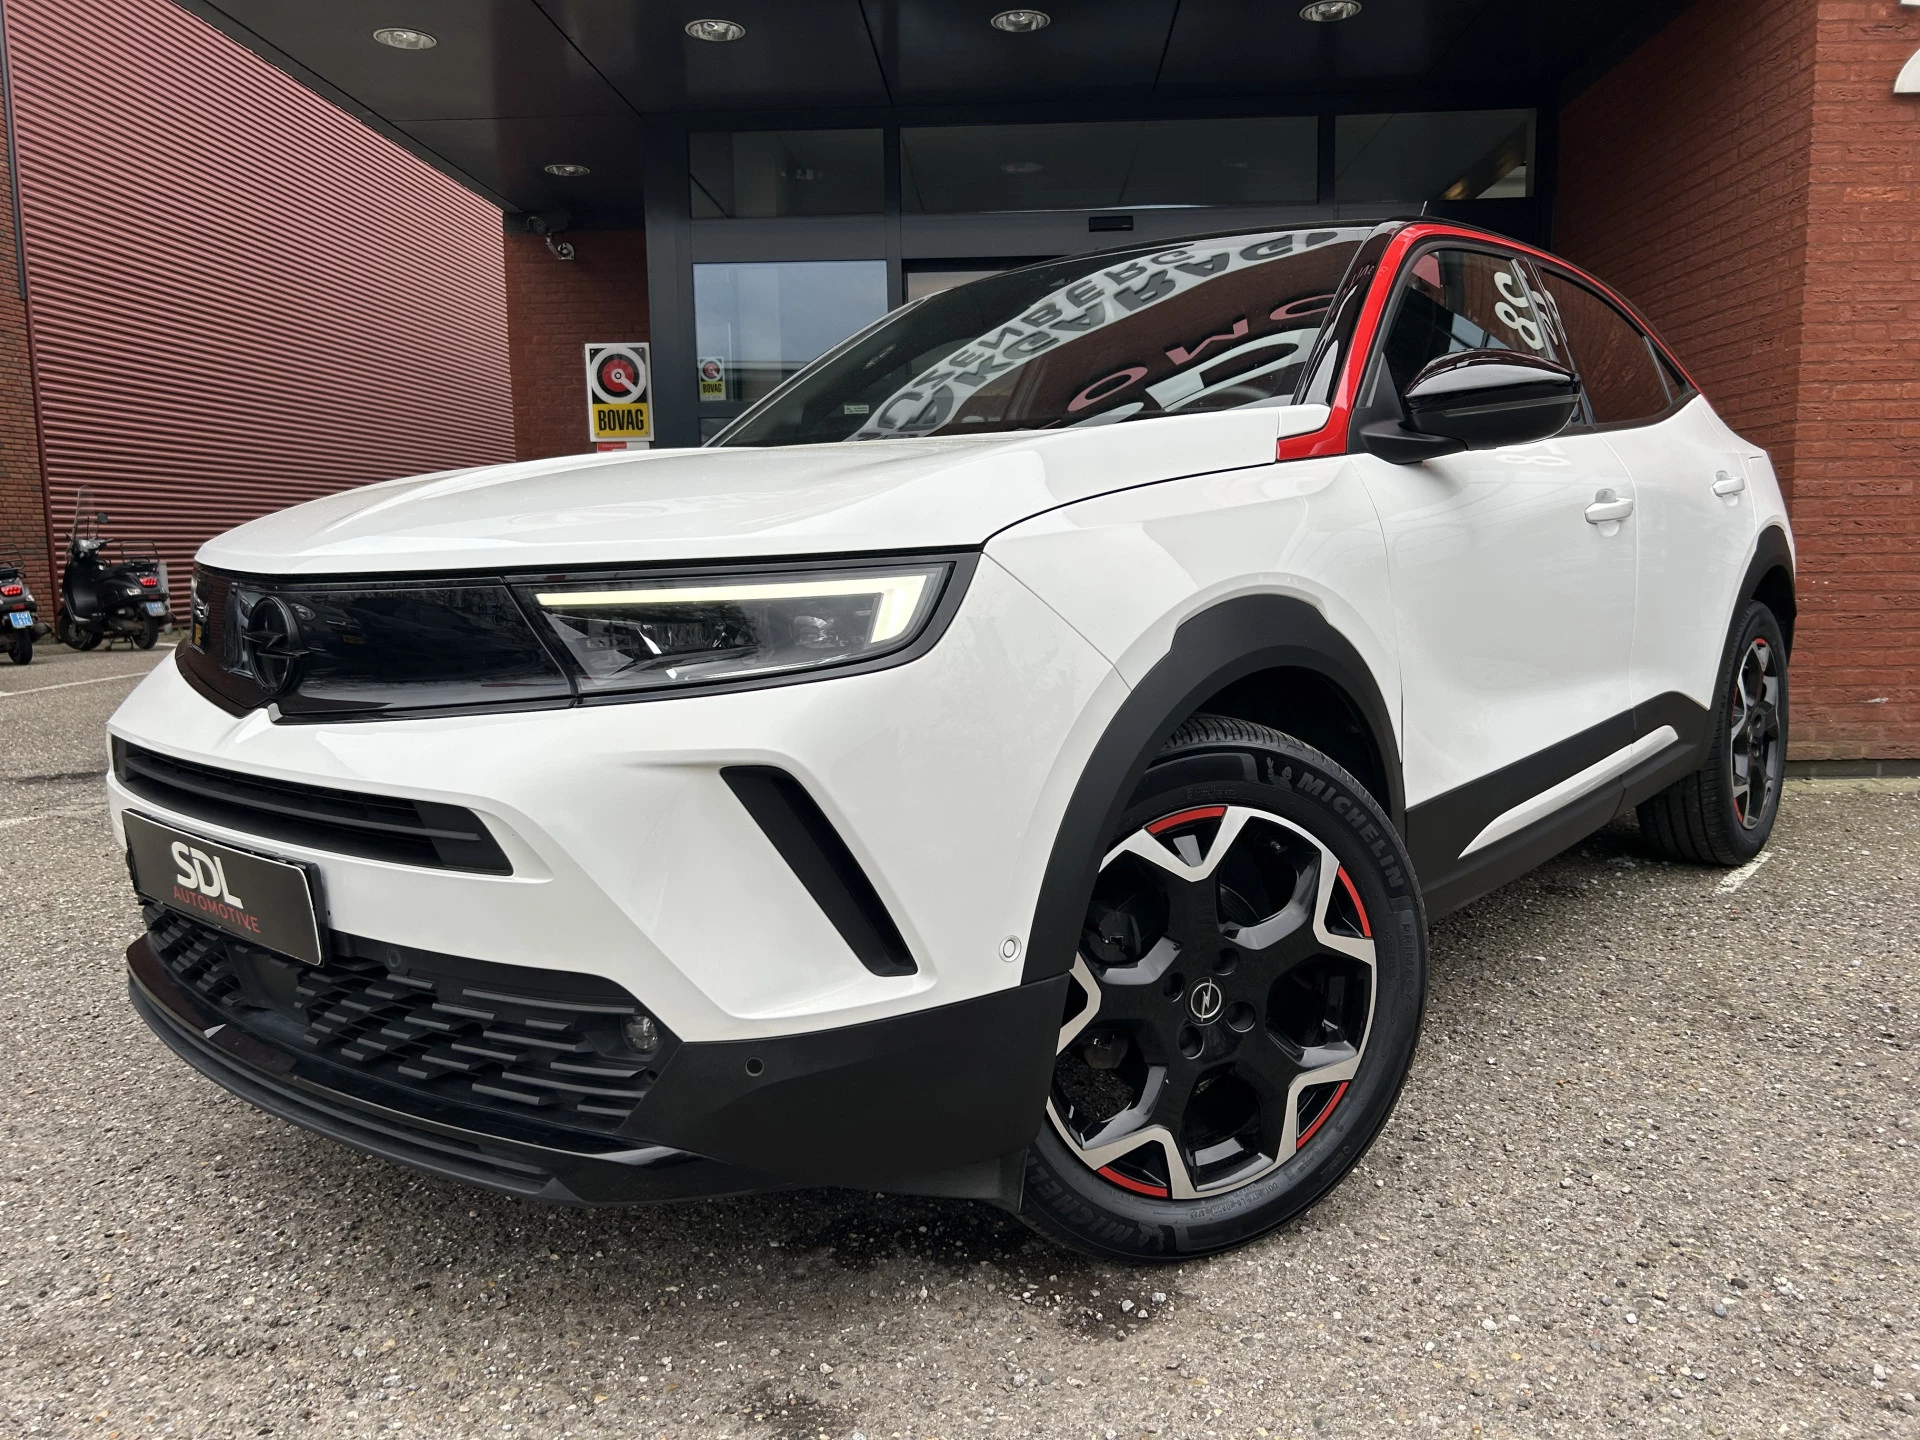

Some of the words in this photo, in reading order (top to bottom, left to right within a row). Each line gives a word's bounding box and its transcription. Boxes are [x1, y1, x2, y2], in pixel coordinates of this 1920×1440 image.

[703, 384, 722, 393] BOVAG
[598, 409, 644, 431] BOVAG
[1297, 772, 1404, 888] MICHELIN
[171, 841, 244, 909] SDL
[173, 885, 261, 933] AUTOMOTIVE
[1025, 1154, 1133, 1243] MICHELI
